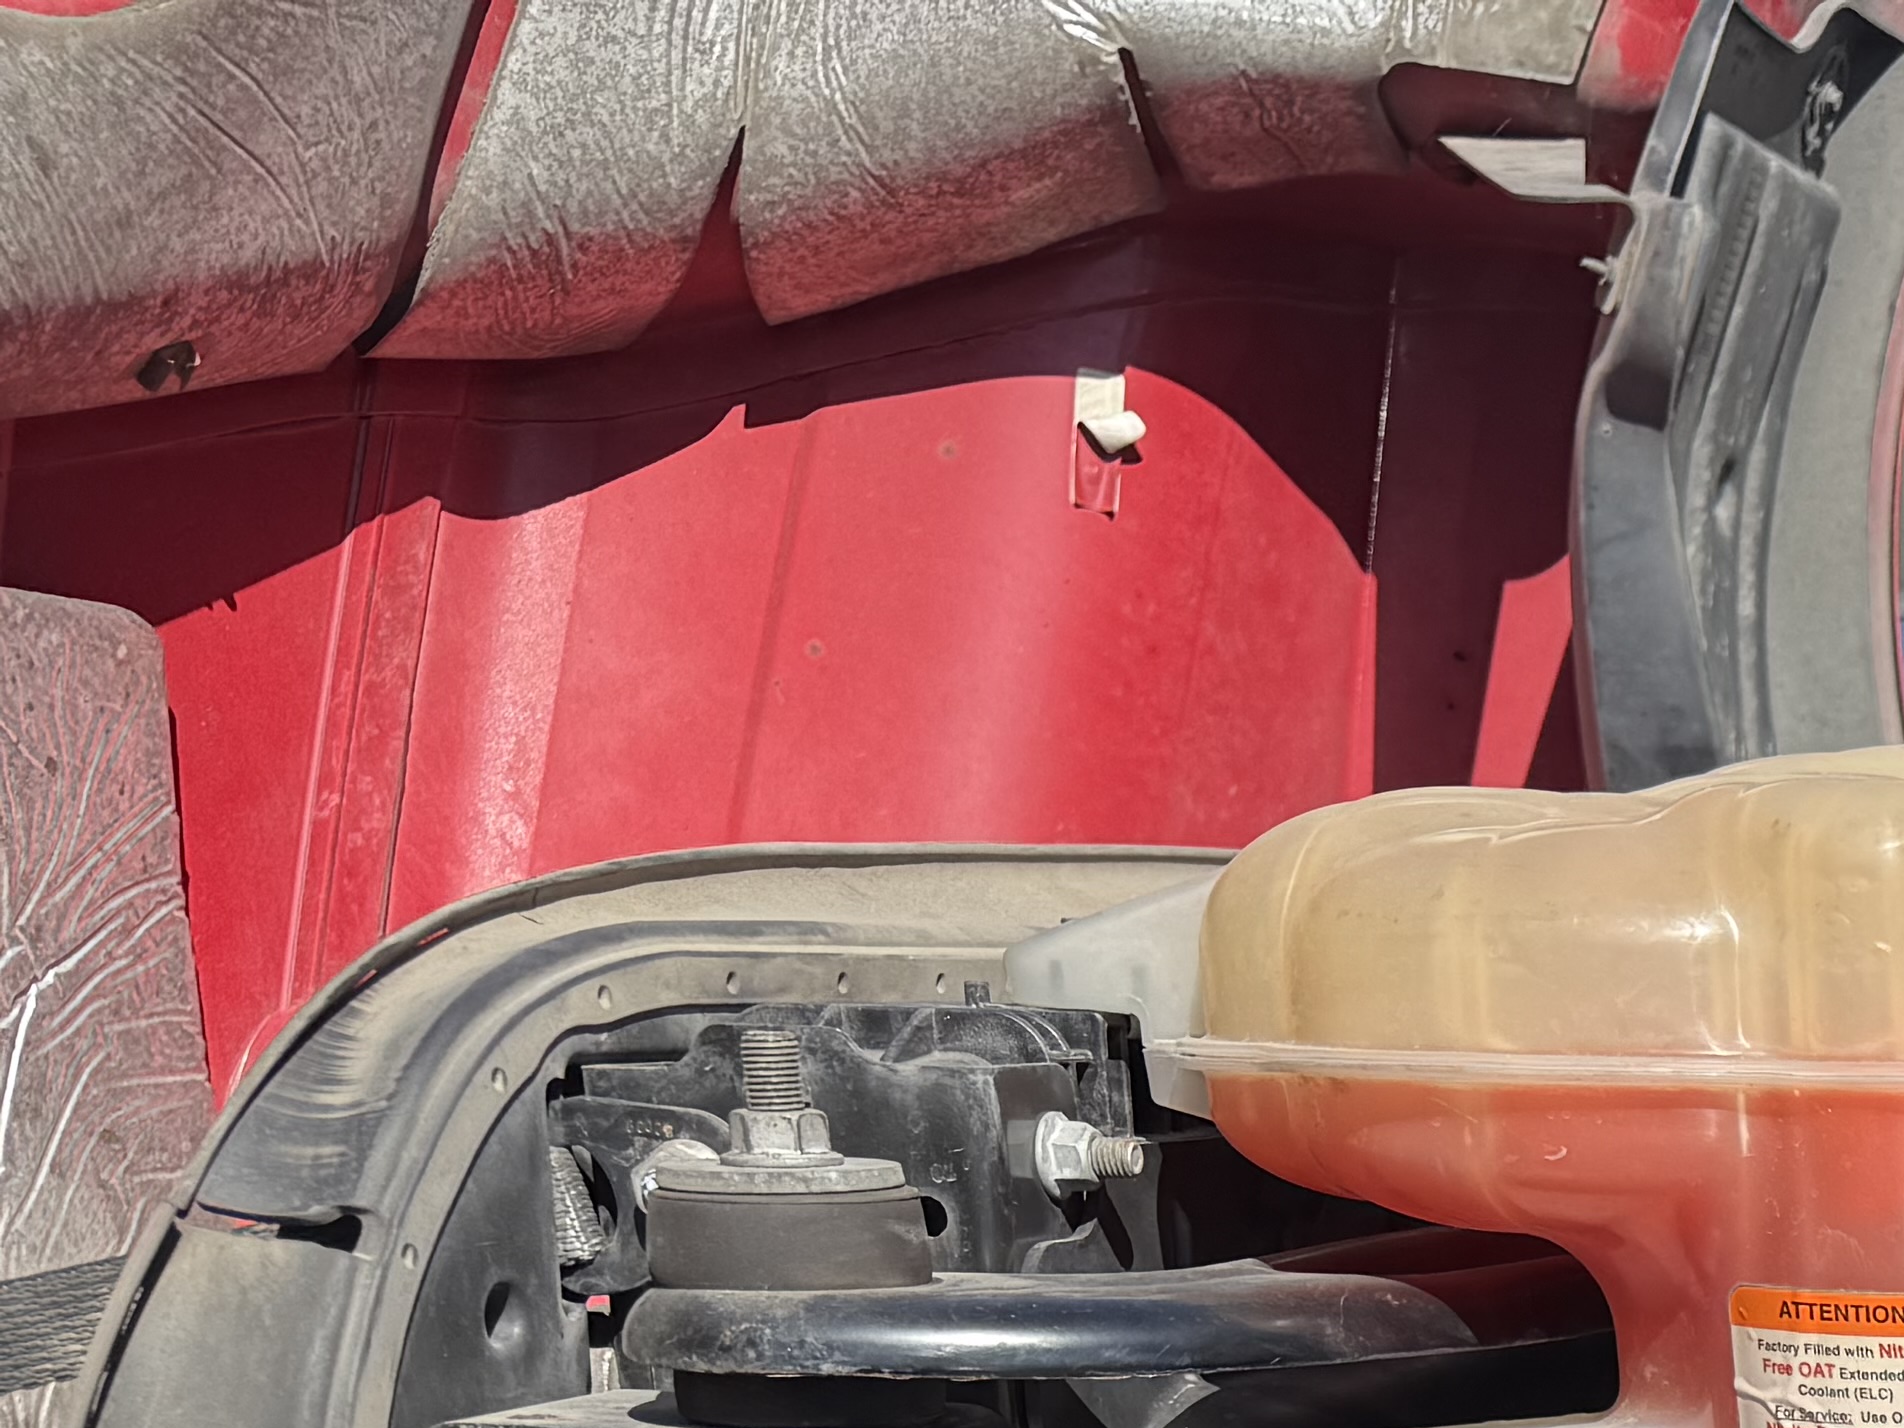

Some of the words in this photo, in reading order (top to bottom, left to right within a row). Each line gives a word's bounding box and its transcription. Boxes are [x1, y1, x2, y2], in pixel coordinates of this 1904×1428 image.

[1757, 1338, 1800, 1358] Factory
[1804, 1342, 1841, 1357] Filled
[1844, 1345, 1875, 1359] with
[1762, 1357, 1794, 1377] Free
[1798, 1360, 1836, 1379] OAT
[1797, 1383, 1850, 1400] Coolant
[1853, 1387, 1894, 1404] (ELC)
[1775, 1404, 1796, 1420] For
[1798, 1407, 1852, 1424] Service:
[1860, 1410, 1888, 1424] Use
